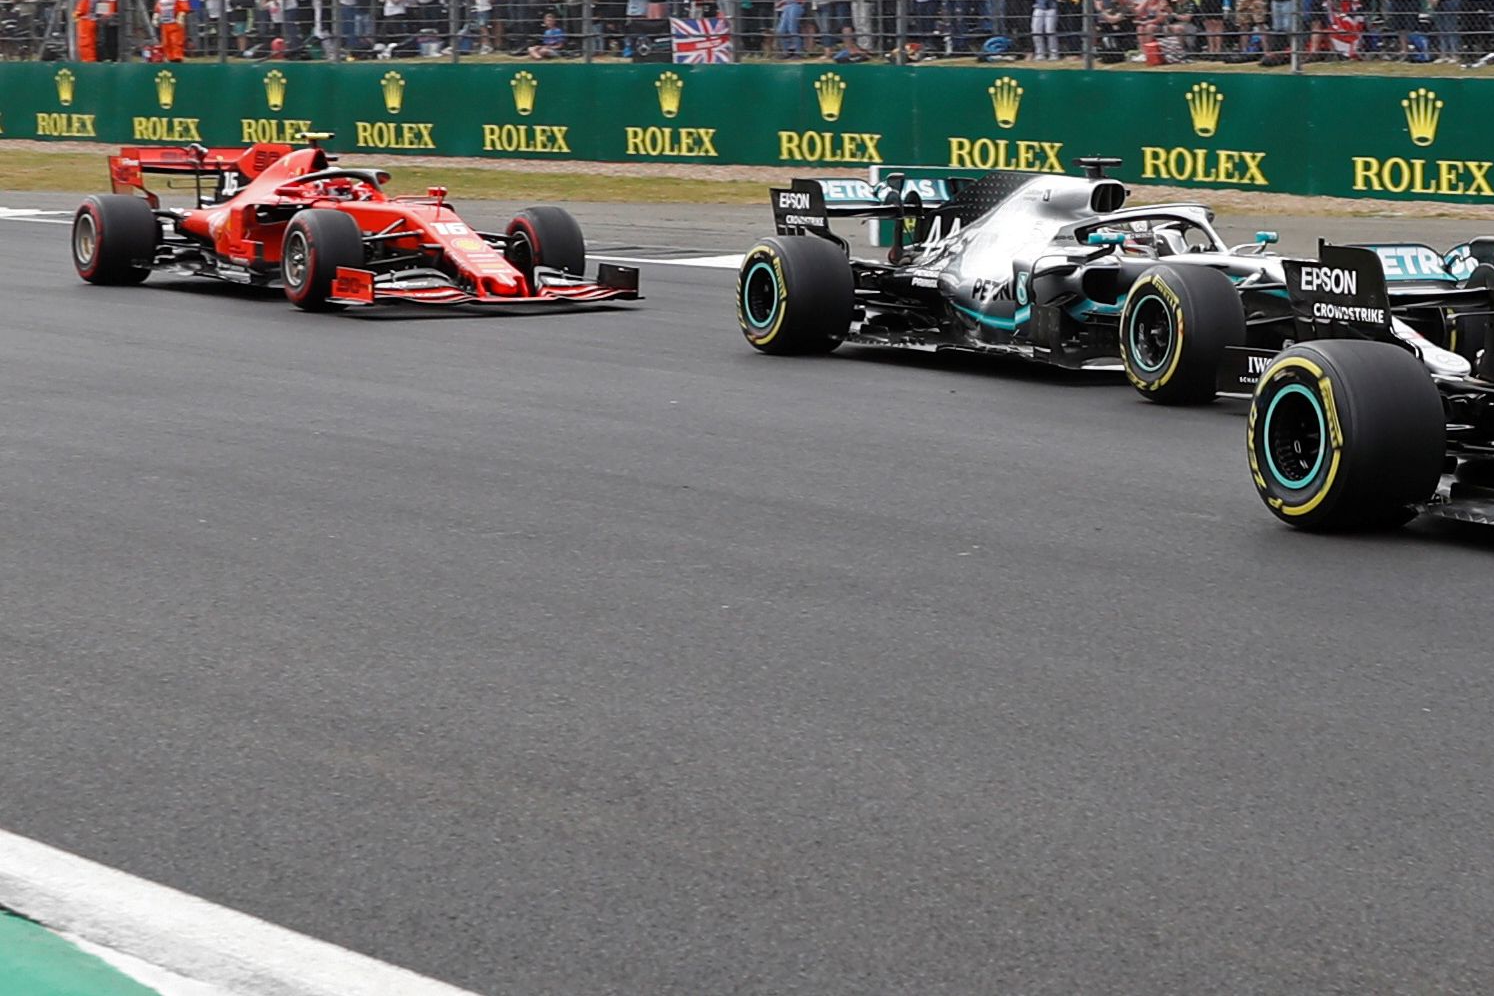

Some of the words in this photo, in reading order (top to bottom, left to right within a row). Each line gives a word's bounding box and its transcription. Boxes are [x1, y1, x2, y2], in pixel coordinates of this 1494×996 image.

[36, 113, 96, 136] ROLEX
[133, 117, 202, 141] ROLEX
[356, 122, 435, 148] ROLEX
[483, 125, 569, 152] ROLEX
[626, 127, 718, 157] ROLEX
[778, 130, 882, 163] ROLEX
[949, 137, 1064, 172] ROLEX
[1141, 147, 1269, 186] ROLEX
[1354, 157, 1494, 196] ROLEX
[779, 192, 810, 210] EPSON
[429, 222, 469, 235] 16
[1300, 266, 1357, 296] EPSON
[1313, 302, 1385, 324] CROWDSTRIKE
